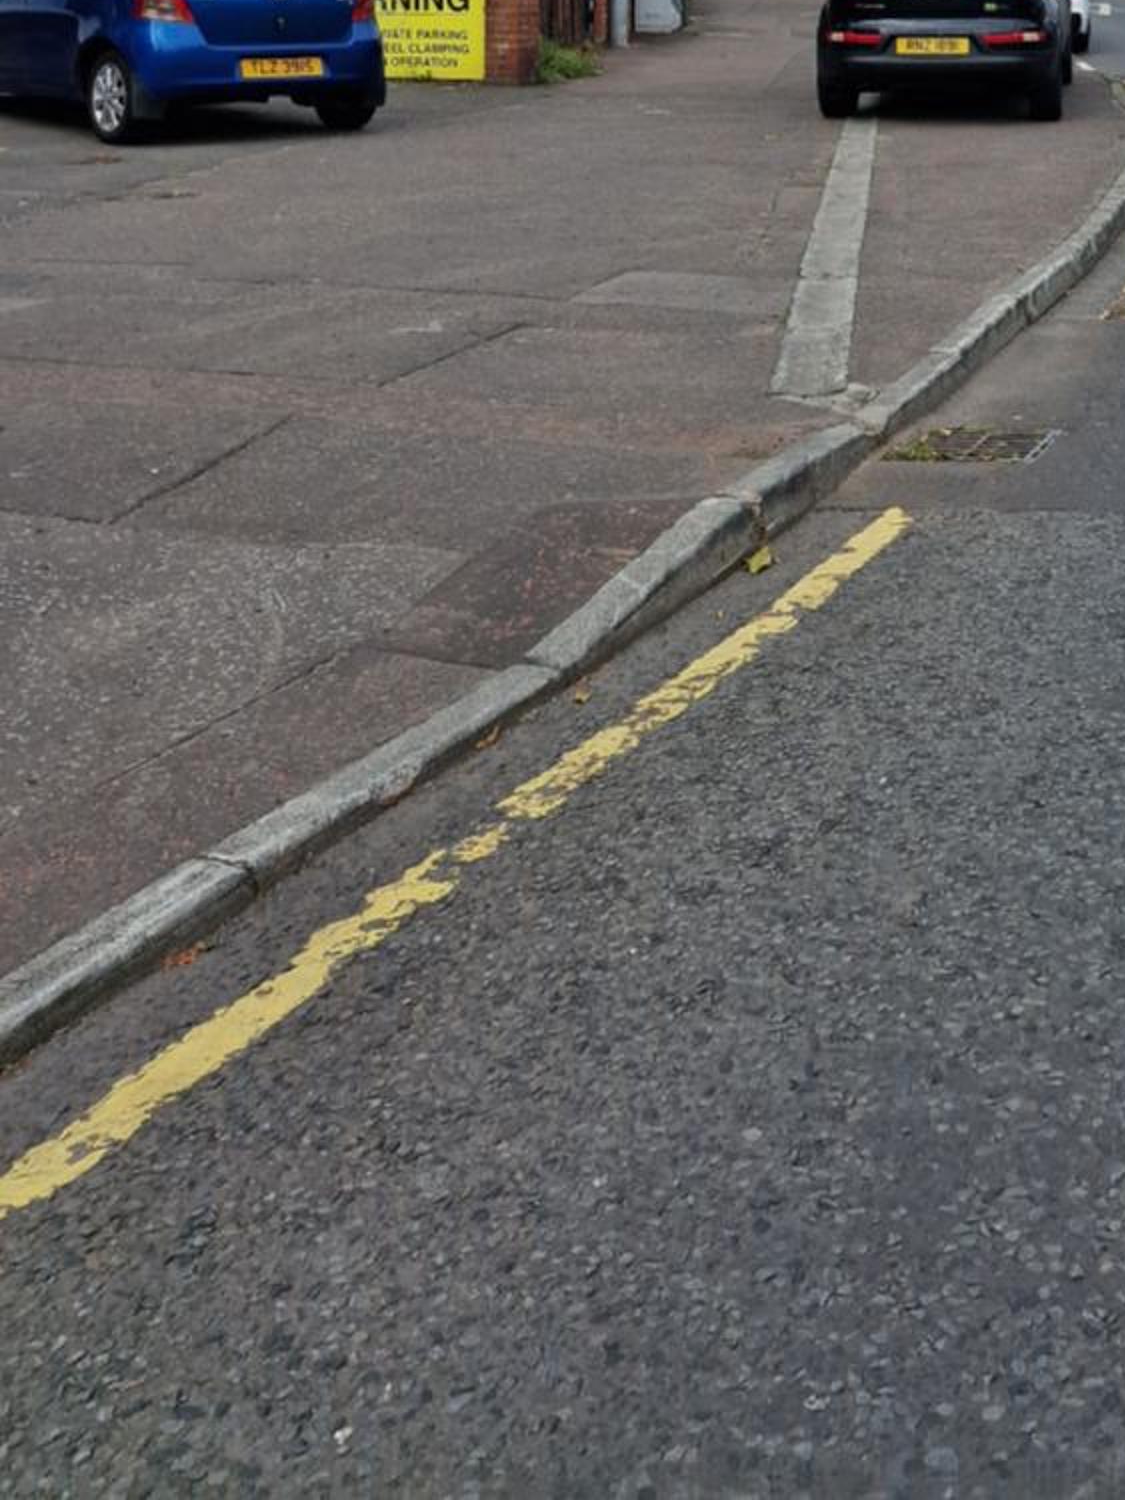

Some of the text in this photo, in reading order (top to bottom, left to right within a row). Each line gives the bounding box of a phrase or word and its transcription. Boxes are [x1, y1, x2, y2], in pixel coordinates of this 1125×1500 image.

[416, 28, 468, 40] PARKING
[408, 44, 470, 54] CLAMPING
[391, 57, 460, 68] OPERATION
